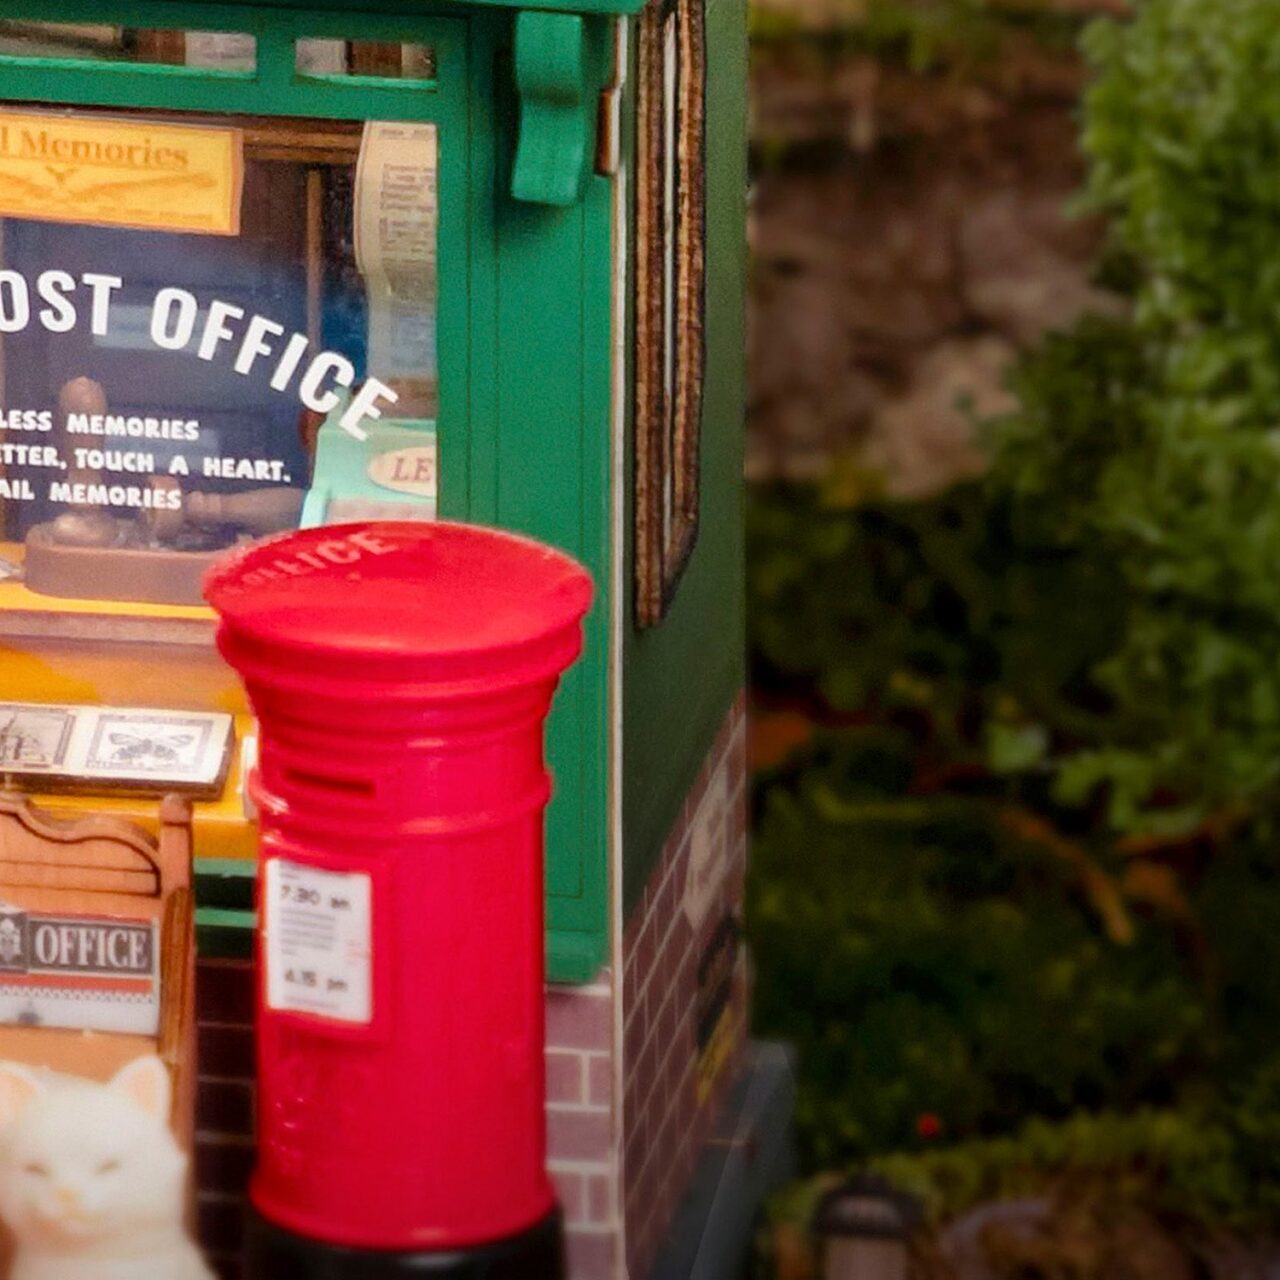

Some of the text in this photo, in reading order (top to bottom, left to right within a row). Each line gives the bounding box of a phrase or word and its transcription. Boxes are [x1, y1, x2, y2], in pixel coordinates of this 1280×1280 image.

[19, 129, 190, 169] Memories
[150, 287, 399, 441] OFFICE
[66, 413, 200, 441] MEMORIES
[73, 447, 155, 473] TOUCH
[168, 454, 190, 476] A
[202, 457, 292, 483] HEART.
[49, 481, 182, 510] MEMORIES
[34, 924, 149, 969] OFFICE
